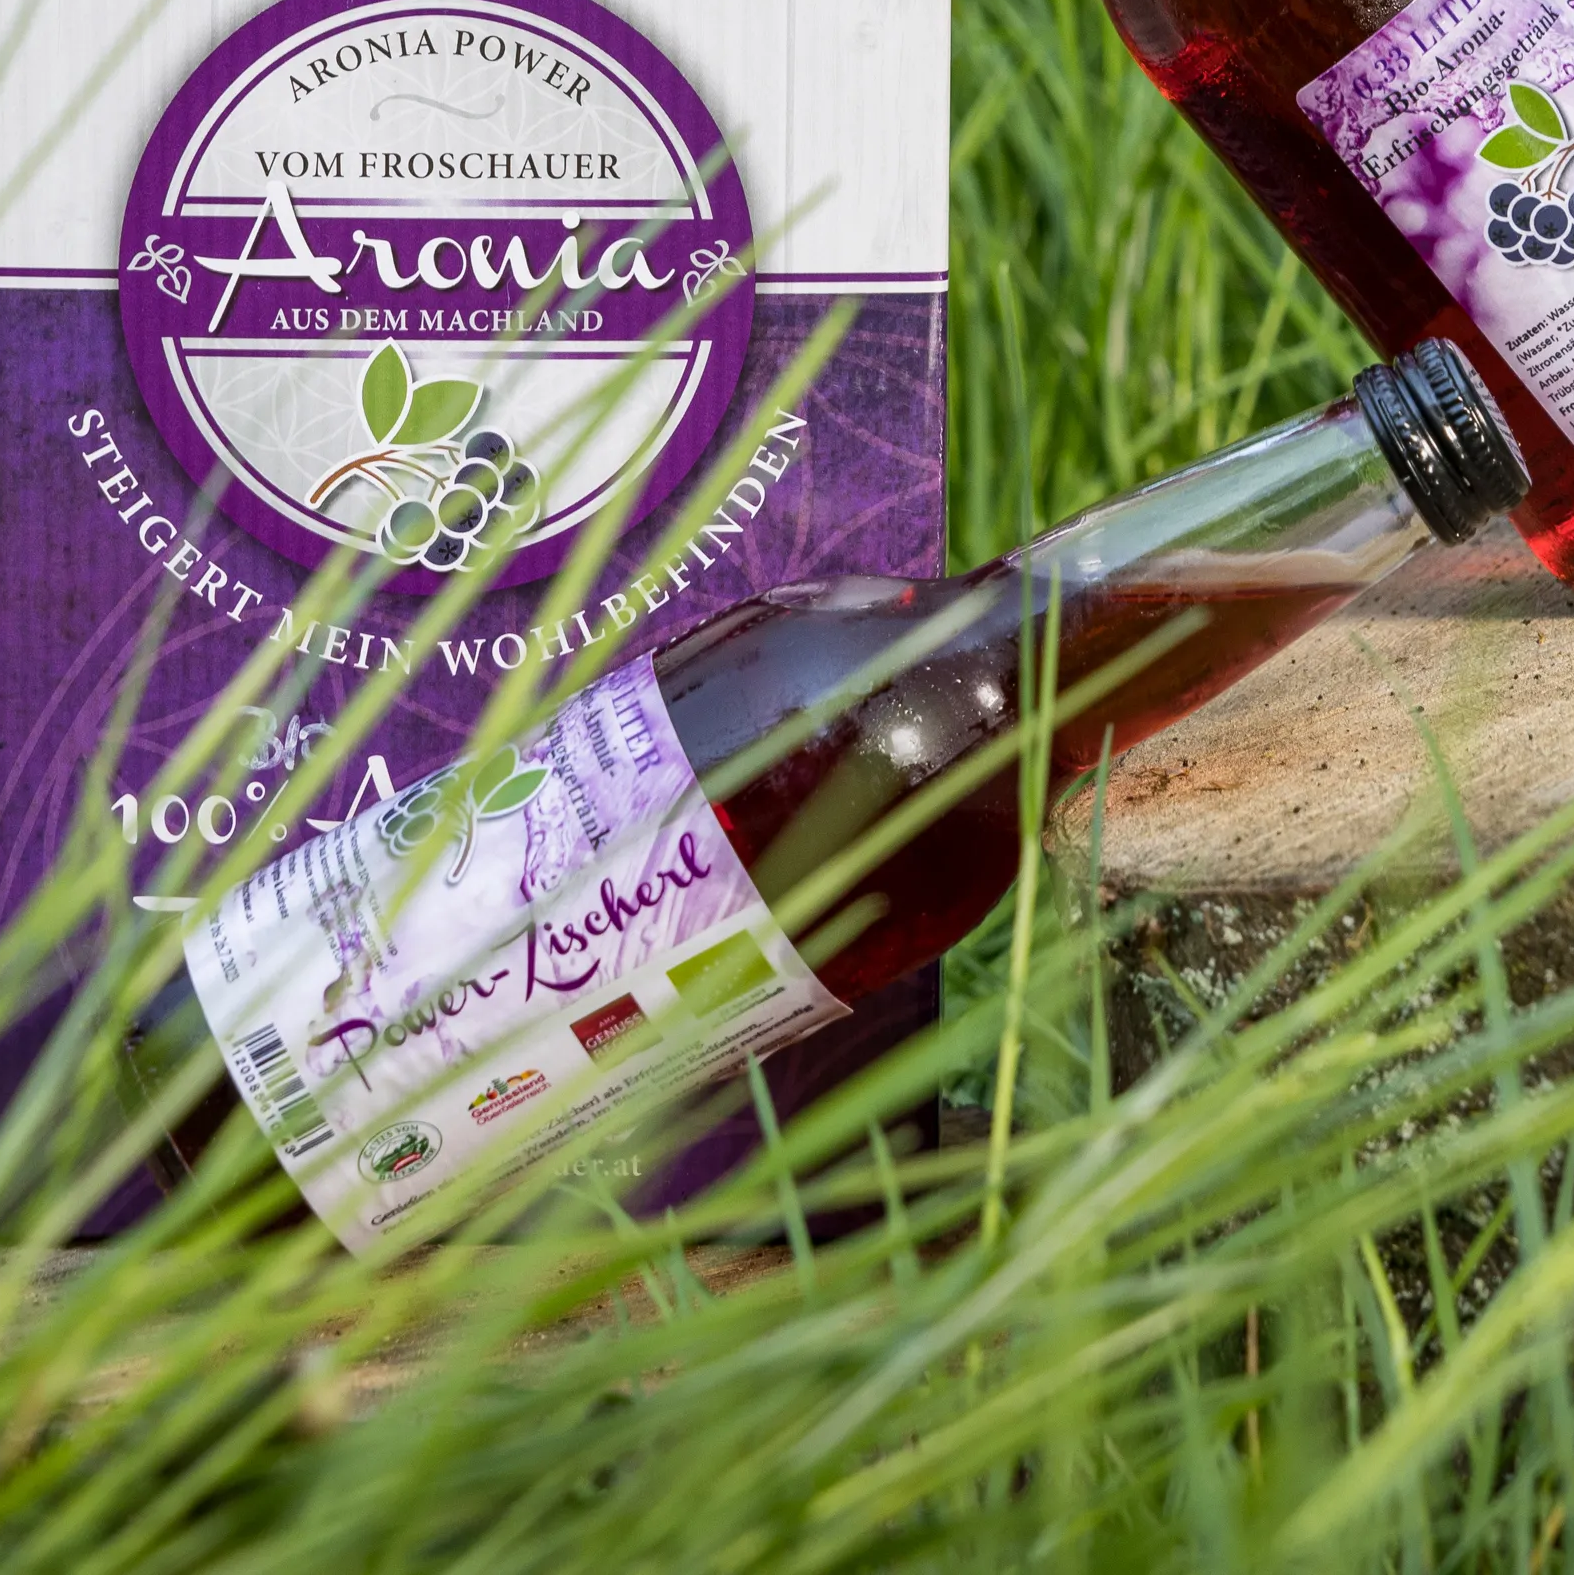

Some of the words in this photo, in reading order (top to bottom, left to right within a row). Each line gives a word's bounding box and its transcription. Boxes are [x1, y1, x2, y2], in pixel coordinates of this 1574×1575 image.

[286, 28, 439, 103] ARONIA
[453, 29, 592, 106] POWER
[1359, 3, 1559, 185] Erfrischungsgetränk
[1381, 10, 1505, 118] Bio-Aronia-
[255, 151, 345, 179] VOM
[359, 152, 620, 179] FROSCHAUER
[193, 180, 675, 334] Aronia
[270, 308, 330, 331] AUS
[340, 308, 409, 332] DEM
[419, 309, 603, 333] MACHLAND
[1505, 320, 1548, 351] Zutaten:
[1516, 335, 1558, 365] (Wasser,
[1539, 366, 1573, 390] Anbau.
[67, 408, 263, 623] STEIGERT
[269, 607, 417, 675] MEIN
[437, 406, 808, 677] WOHLBEFINDEN
[611, 685, 662, 776] LITER
[111, 780, 289, 845] 100%
[307, 830, 711, 1092] Power-Zischerl
[584, 1011, 643, 1050] GENUSS
[469, 1072, 546, 1120] Genussland
